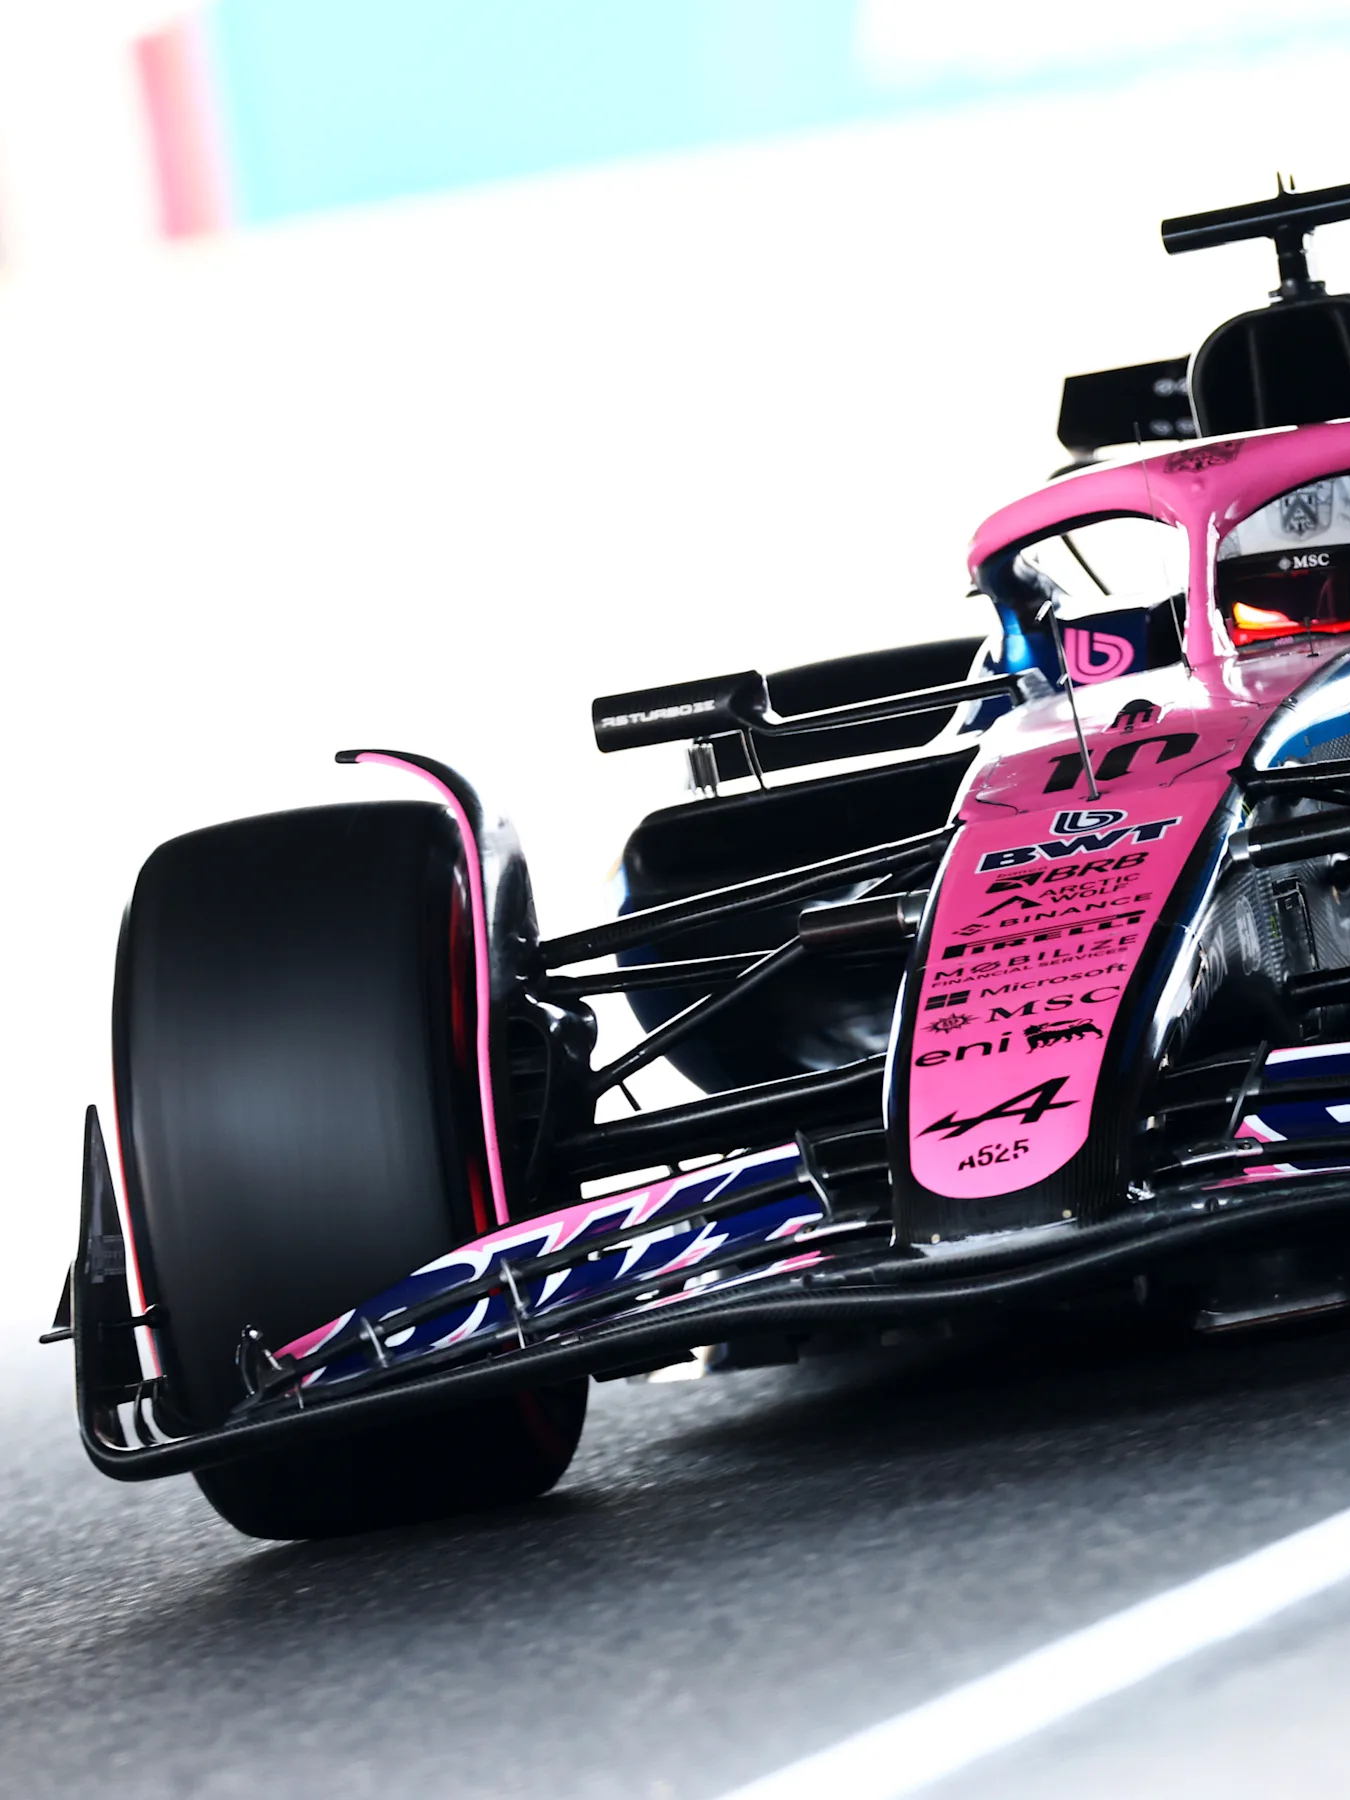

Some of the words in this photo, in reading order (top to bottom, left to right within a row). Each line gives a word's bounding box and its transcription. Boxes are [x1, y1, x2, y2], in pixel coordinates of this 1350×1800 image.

[1292, 553, 1330, 569] MSC
[1043, 733, 1199, 794] 10
[975, 816, 1183, 874] BWT
[1043, 852, 1149, 883] BRB
[1038, 873, 1140, 898] ARCTIC
[1051, 883, 1128, 903] WOLF
[1000, 892, 1152, 927] BINANCE
[941, 910, 1146, 961] PIRELLI
[931, 965, 1034, 988] FINANCIAL
[1038, 947, 1128, 968] SERVICES
[980, 963, 1128, 998] Microsoft
[984, 986, 1120, 1023] MSC
[915, 1031, 1013, 1067] eni
[958, 1139, 1029, 1171] A525
